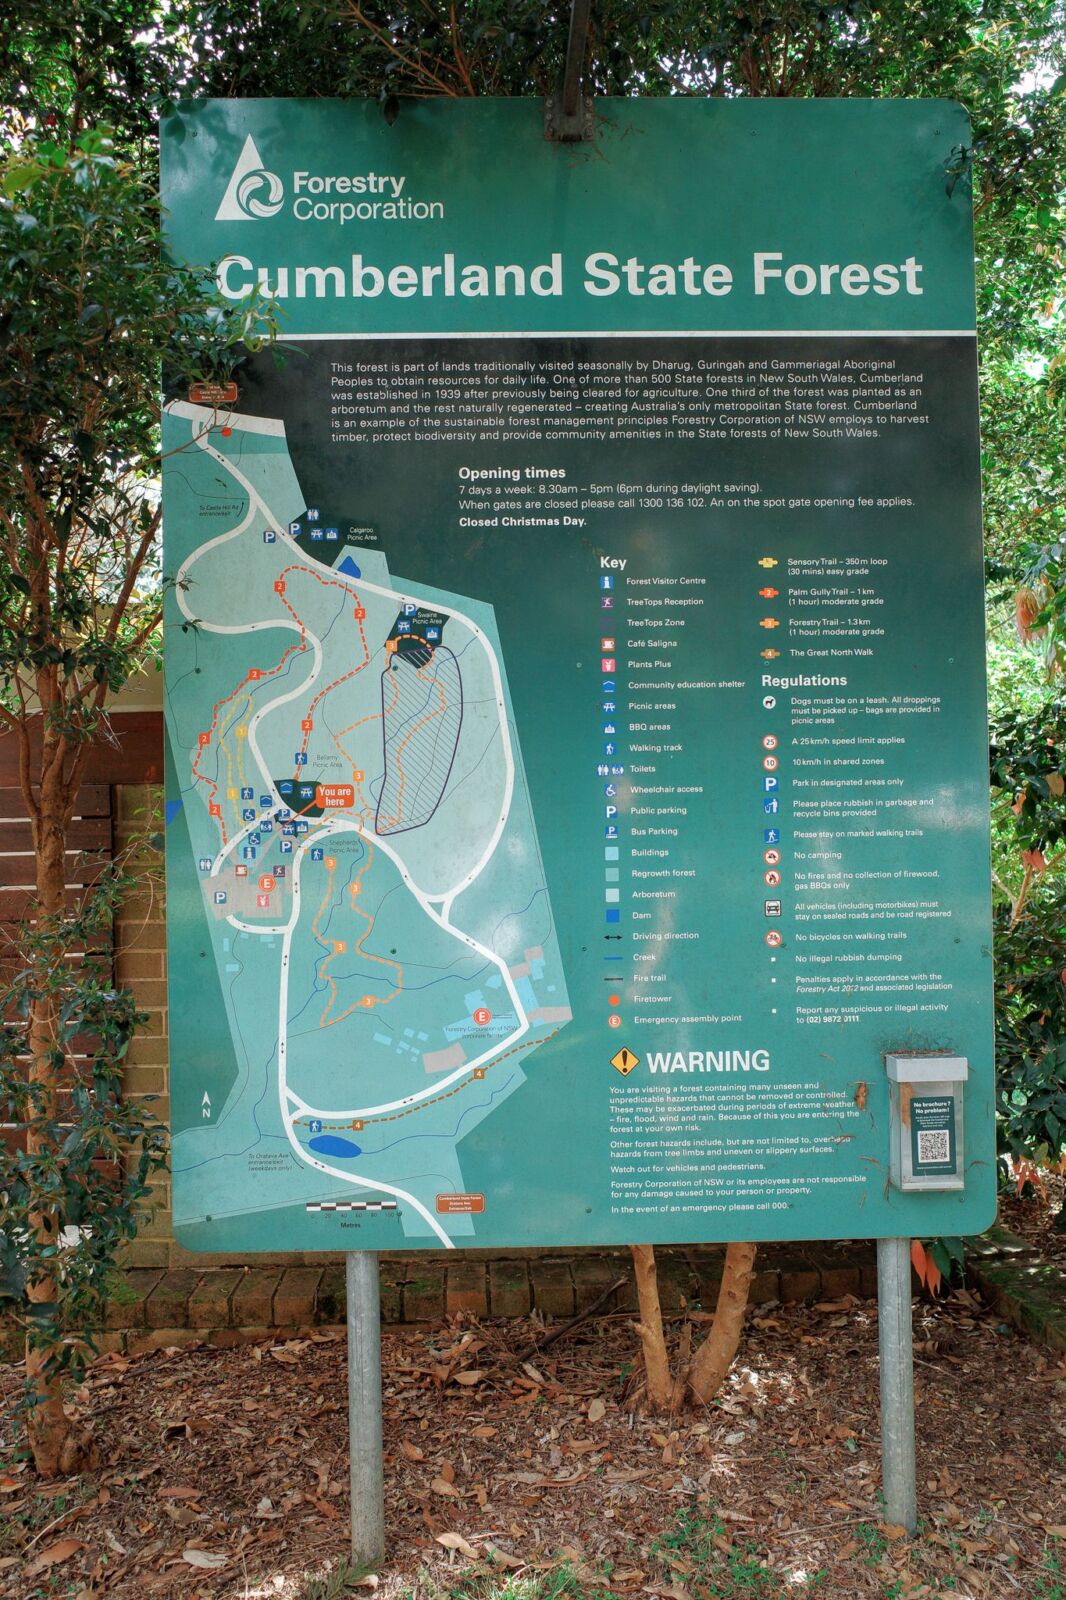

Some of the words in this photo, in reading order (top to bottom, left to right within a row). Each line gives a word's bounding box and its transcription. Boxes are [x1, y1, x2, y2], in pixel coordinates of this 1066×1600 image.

[294, 170, 406, 198] Forestry
[292, 198, 444, 224] Corporation
[217, 254, 562, 300] Cumberland
[584, 251, 732, 296] State
[754, 251, 922, 296] Forest
[330, 362, 352, 372] This
[356, 362, 387, 372] forest
[392, 362, 399, 371] is
[404, 363, 424, 372] part
[428, 362, 438, 371] of
[442, 362, 470, 371] lands
[474, 361, 535, 372] traditionally
[539, 360, 573, 370] visited
[578, 360, 632, 371] seasonally
[636, 360, 648, 371] by
[652, 360, 692, 371] Dharug,
[697, 359, 744, 371] Guringah
[748, 360, 767, 369] and
[771, 359, 840, 371] Gammeriagal
[843, 360, 894, 370] Aboriginal
[459, 467, 520, 481] Opening
[524, 466, 565, 478] times
[458, 500, 490, 509] When
[493, 501, 521, 510] gates
[544, 499, 577, 508] closed
[581, 498, 614, 509] please
[618, 498, 634, 507] call
[639, 498, 662, 507] 1300
[666, 498, 683, 507] 136
[687, 497, 706, 506] 102.
[710, 497, 724, 506] An
[743, 497, 759, 506] the
[763, 498, 785, 508] spot
[788, 498, 810, 508] gate
[814, 497, 854, 508] opening
[858, 496, 873, 506] fee
[876, 496, 914, 507] applies.
[459, 517, 497, 526] Closed
[502, 516, 559, 526] Christmas
[563, 516, 586, 527] Day.
[600, 556, 626, 570] Key
[626, 598, 662, 606] TreeTops
[664, 597, 703, 606] Reception
[861, 598, 883, 606] grade
[627, 618, 662, 627] TreeTops
[647, 639, 676, 648] Saligna
[628, 681, 674, 689] Community
[762, 674, 847, 689] Regulations
[629, 744, 661, 752] Walking
[820, 779, 862, 787] designated
[886, 778, 903, 786] only
[319, 786, 336, 796] You
[326, 797, 344, 806] here
[657, 806, 686, 815] parking
[648, 827, 677, 836] Parking
[632, 848, 668, 857] Buildings
[808, 852, 841, 862] camping
[264, 878, 271, 888] E
[216, 892, 225, 903] P
[809, 933, 840, 941] bicycles
[855, 932, 885, 940] walking
[809, 955, 832, 963] illegal
[866, 953, 902, 961] dumping
[478, 1012, 486, 1021] E
[634, 1016, 678, 1024] Emergency
[681, 1015, 718, 1023] assembly
[646, 1049, 769, 1073] WARNING
[642, 1085, 670, 1094] visiting
[704, 1083, 747, 1093] containing
[773, 1083, 801, 1092] unseen
[202, 1108, 210, 1118] N
[717, 1162, 765, 1171] pedestrians.
[728, 1203, 754, 1211] please
